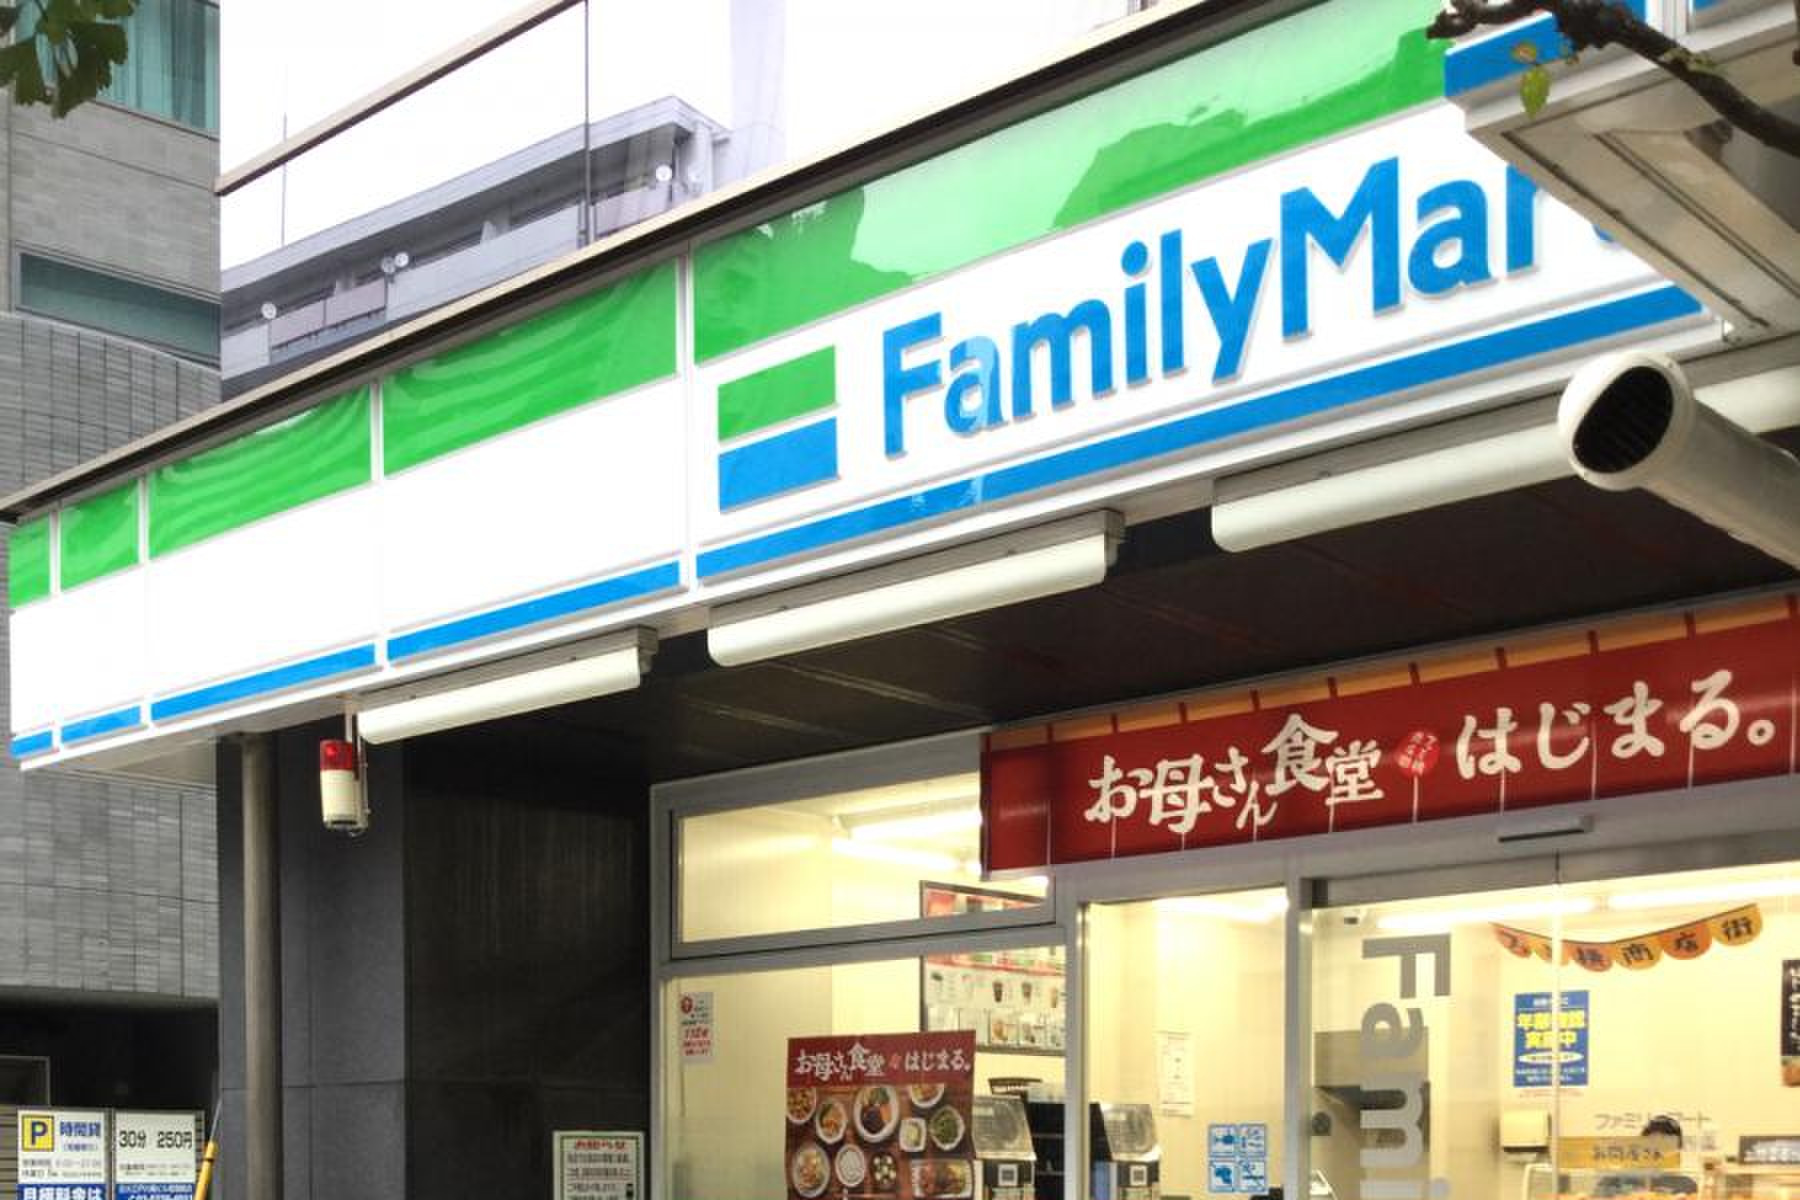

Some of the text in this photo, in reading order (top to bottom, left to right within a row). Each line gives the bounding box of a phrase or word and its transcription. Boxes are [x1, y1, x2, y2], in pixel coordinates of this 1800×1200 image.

[883, 157, 1613, 457] FamilyMar
[1084, 669, 1775, 833] お母さん食堂 はじまる。
[31, 1121, 48, 1146] P
